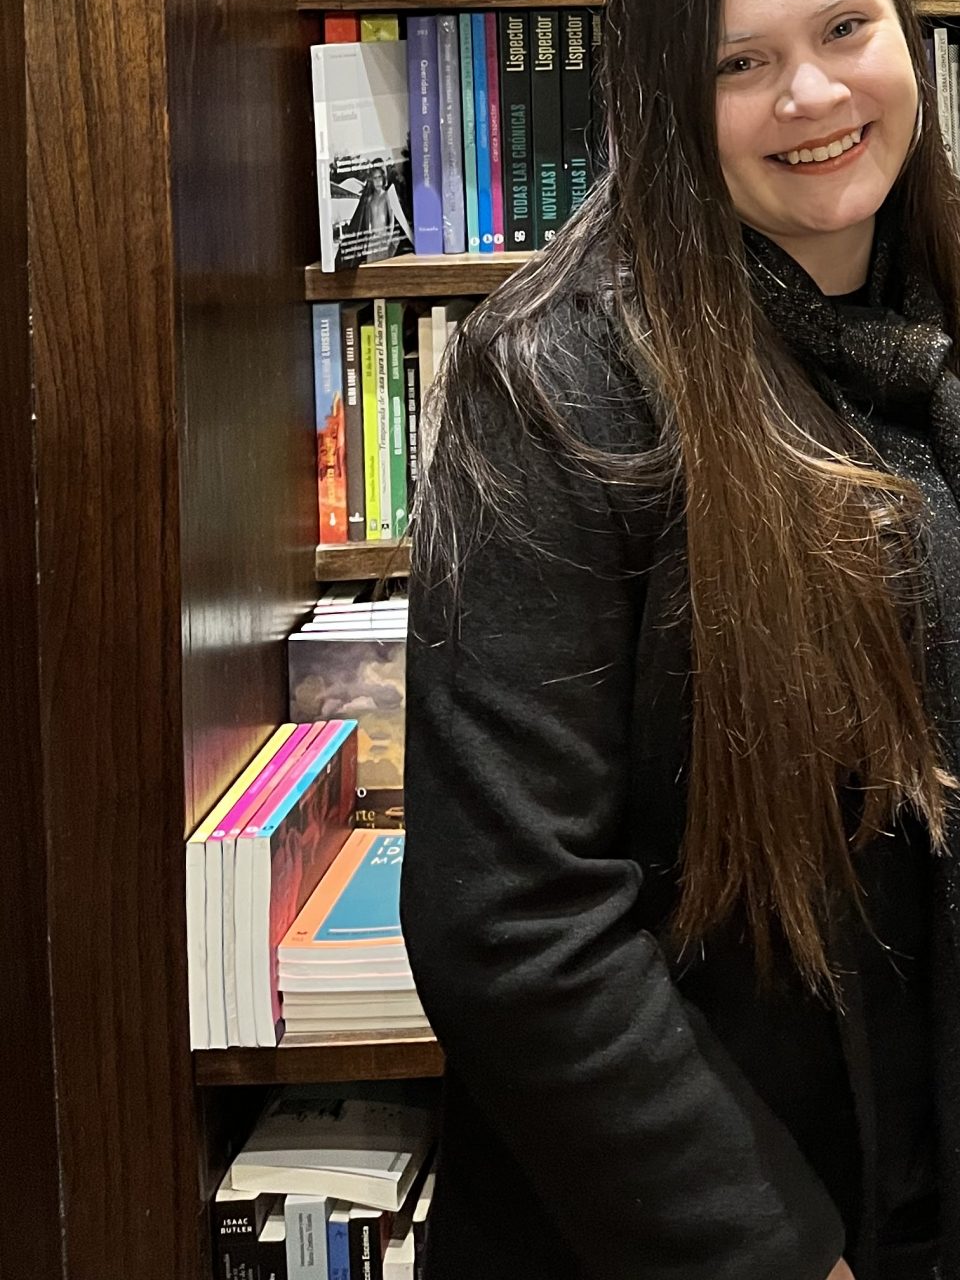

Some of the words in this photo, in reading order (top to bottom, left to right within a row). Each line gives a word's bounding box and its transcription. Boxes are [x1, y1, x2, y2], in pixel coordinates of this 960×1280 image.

[506, 16, 524, 72] Lispector
[535, 15, 552, 71] Lispector
[565, 15, 583, 70] Lispector
[419, 59, 429, 95] Queridas
[490, 104, 499, 136] lispector
[511, 103, 526, 160] CRÓNICAS
[422, 125, 431, 153] Clarice
[491, 137, 499, 162] clarice
[423, 154, 432, 188] Lispector
[513, 164, 527, 185] LAS
[571, 158, 586, 167] II
[514, 189, 528, 220] TODAS
[542, 170, 557, 220] NOVELAS
[571, 171, 586, 211] OVELAS
[375, 305, 385, 329] negro
[320, 319, 330, 356] LUISELLI
[376, 330, 384, 347] león
[376, 348, 384, 356] el
[376, 358, 386, 375] para
[376, 376, 384, 394] caza
[377, 395, 385, 405] de
[221, 1225, 253, 1234] BUTLER
[222, 1217, 248, 1226] ISAAC
